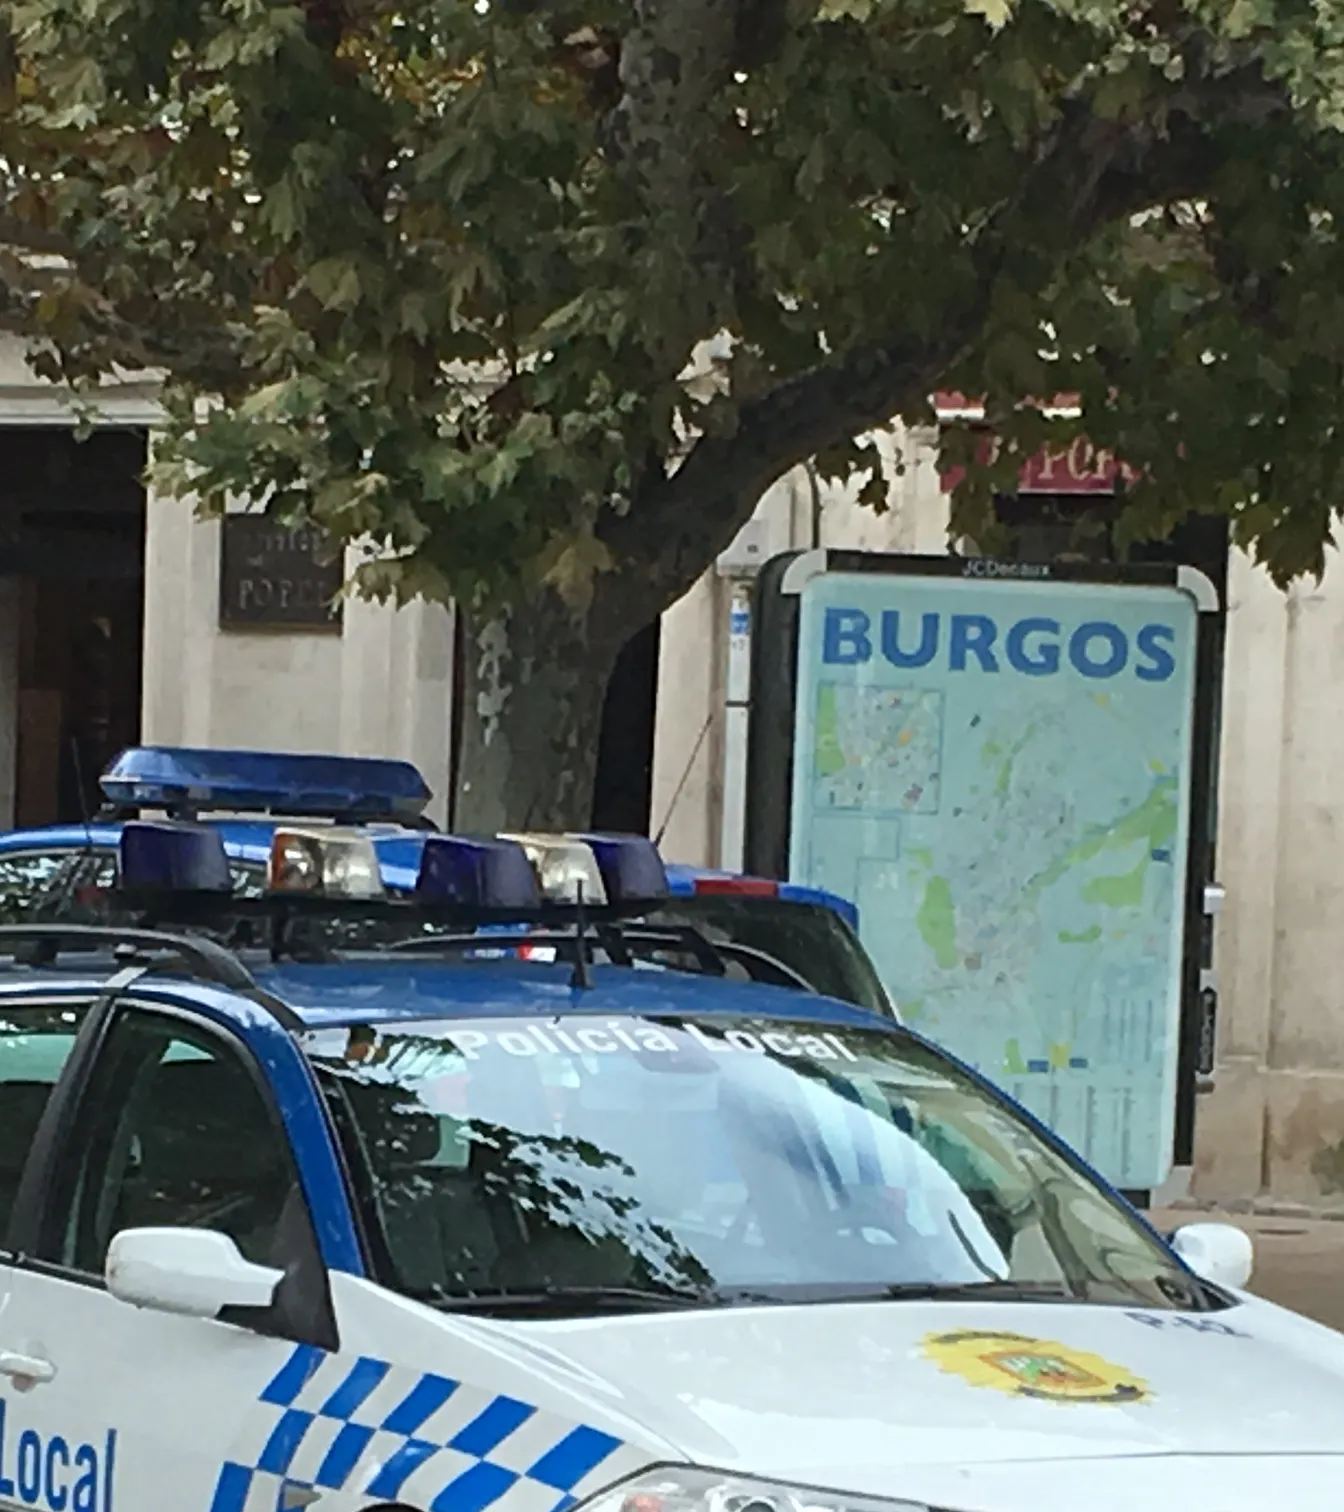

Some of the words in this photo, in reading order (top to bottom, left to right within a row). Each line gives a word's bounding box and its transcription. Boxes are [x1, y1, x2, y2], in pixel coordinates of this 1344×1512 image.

[822, 607, 1176, 681] BURGOS
[446, 1019, 678, 1061] Policía
[683, 1022, 858, 1062] Local
